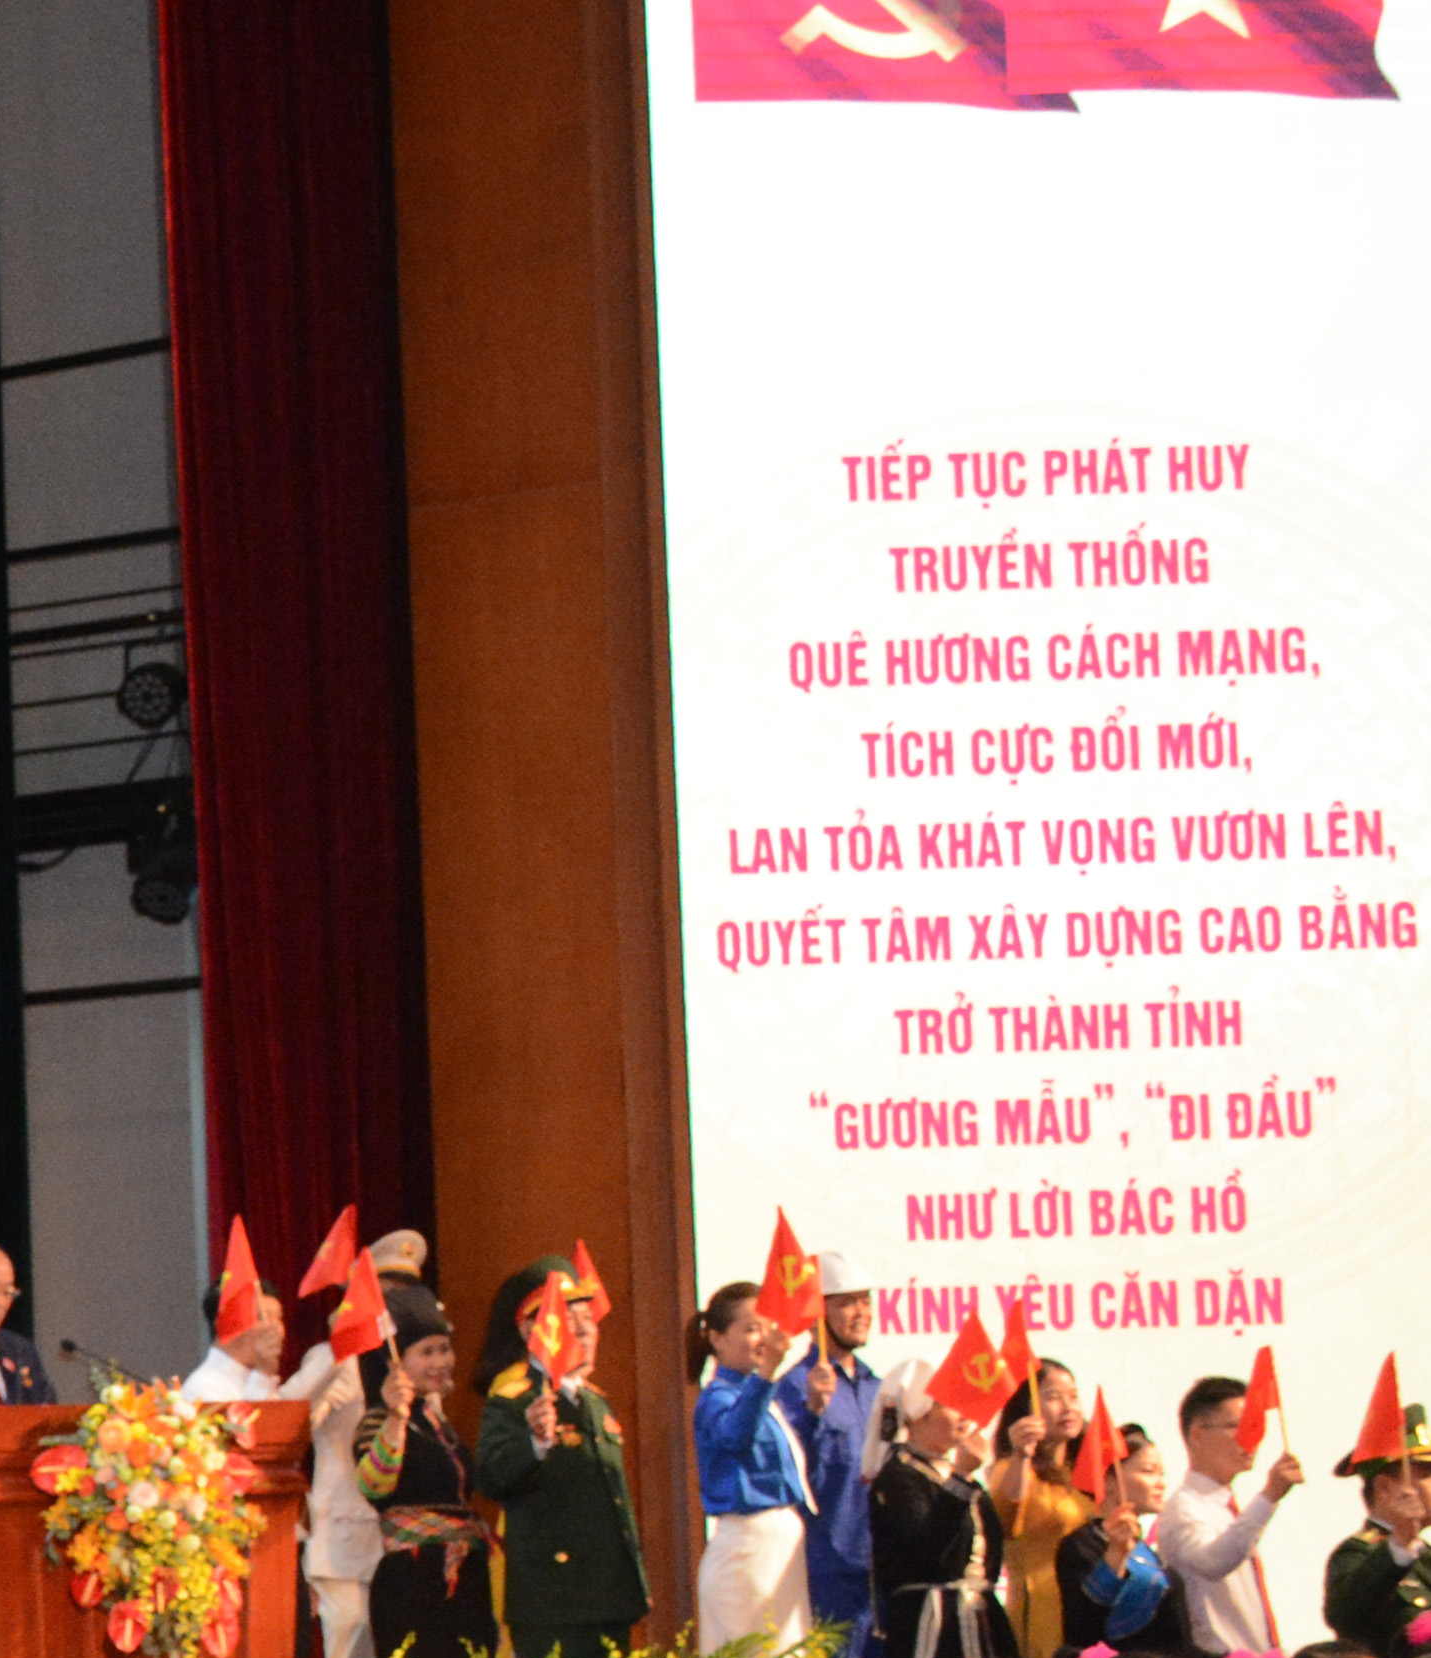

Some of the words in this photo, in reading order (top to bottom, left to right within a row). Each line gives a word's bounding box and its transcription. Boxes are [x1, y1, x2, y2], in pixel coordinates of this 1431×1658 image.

[842, 440, 931, 501] TIẾP
[948, 451, 1026, 508] TỤC
[1045, 438, 1151, 495] PHÁT
[1169, 444, 1248, 491] HUY
[1068, 523, 1208, 587] THỐNG
[790, 631, 868, 692] QUÊ
[886, 633, 1030, 685] HƯƠNG
[1048, 624, 1159, 680] CÁCH
[1178, 627, 1319, 686] MẠNG,
[861, 723, 953, 778] TÍCH
[972, 726, 1053, 785] CỰC
[1071, 706, 1139, 772] ĐỔI
[1158, 718, 1251, 771] MỚI,
[730, 828, 807, 874] LAN
[824, 810, 902, 871] TỎA
[919, 812, 1025, 869] KHÁT
[1042, 817, 1155, 875] VỌNG
[1172, 811, 1285, 861] VƯƠN
[1305, 801, 1395, 859] LÊN,
[718, 905, 845, 972] QUYẾT
[861, 907, 951, 962] TÂM
[969, 908, 1047, 960] XÂY
[1067, 906, 1181, 967] DỰNG
[1200, 906, 1281, 954] CAO
[1299, 886, 1417, 950] BẰNG
[894, 993, 973, 1054] TRỞ
[988, 996, 1129, 1052] THÀNH
[1145, 986, 1241, 1048] TỈNH
[907, 1188, 997, 1241] NHƯ
[1010, 1180, 1072, 1238] LỜI
[1090, 1181, 1174, 1236] BÁC
[879, 1278, 980, 1336] KÍNH
[995, 1275, 1073, 1333] YÊU
[1091, 1272, 1178, 1329] CĂN
[1195, 1270, 1283, 1336] DẶN
